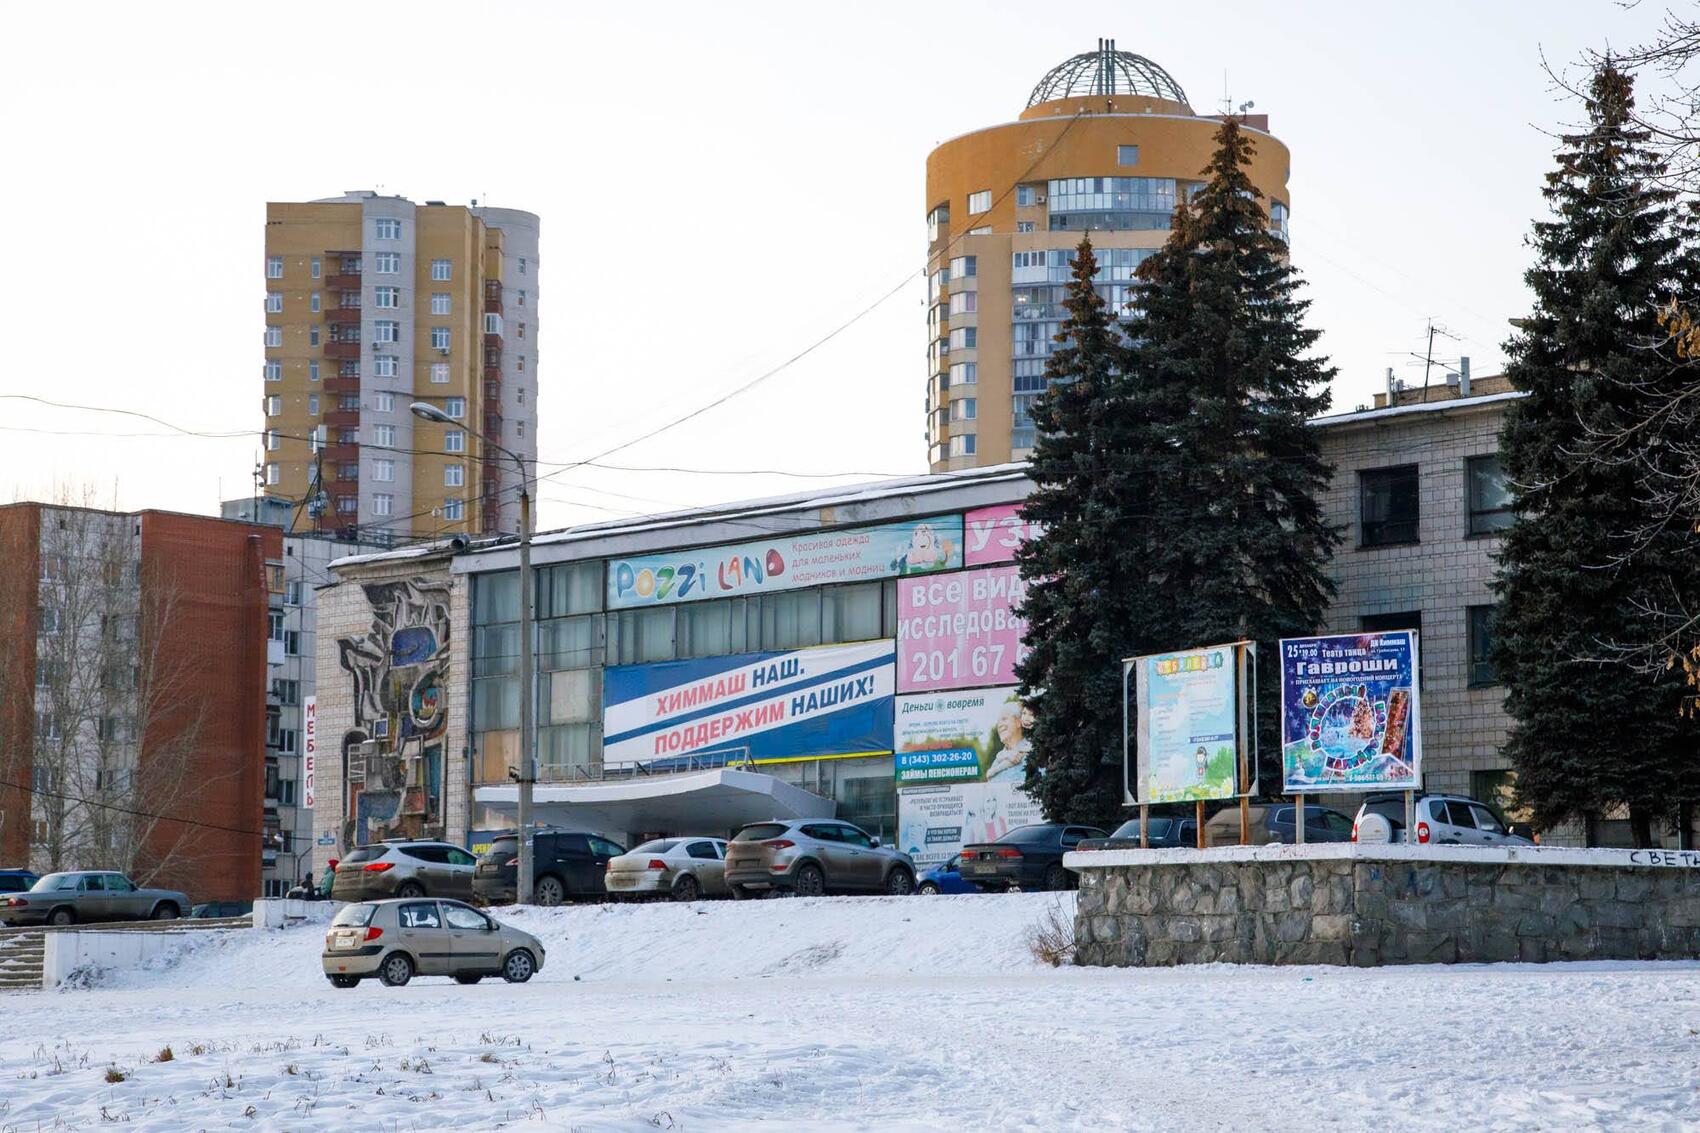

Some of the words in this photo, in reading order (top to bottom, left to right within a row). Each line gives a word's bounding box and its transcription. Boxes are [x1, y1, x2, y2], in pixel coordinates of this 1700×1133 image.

[836, 535, 870, 548] одежда
[792, 559, 809, 568] для
[811, 551, 861, 565] маленьких
[718, 549, 785, 590] LAND
[792, 570, 836, 583] модников
[848, 565, 885, 578] модниц
[912, 580, 963, 608] все
[972, 574, 1026, 603] вид
[1287, 645, 1298, 658] 25
[1322, 650, 1343, 658] Театр
[1344, 648, 1366, 657] танца
[912, 649, 959, 683] 201
[972, 644, 1005, 677] 67
[656, 673, 746, 716] ХИММАШ
[752, 658, 805, 688] НАШ.
[654, 702, 785, 754] ПОДДЕРЖИМ
[791, 674, 875, 717] НАШИХ!
[902, 702, 934, 714] Деньги
[946, 698, 985, 710] вовремя
[306, 703, 315, 806] МЕБЕЛЬ
[901, 756, 907, 765] 8
[909, 755, 930, 766] (343)
[932, 752, 972, 762] 302-26-20
[901, 769, 928, 780] ЗАЙМЫ
[928, 766, 978, 778] ПЕНСИОНЕРАМ
